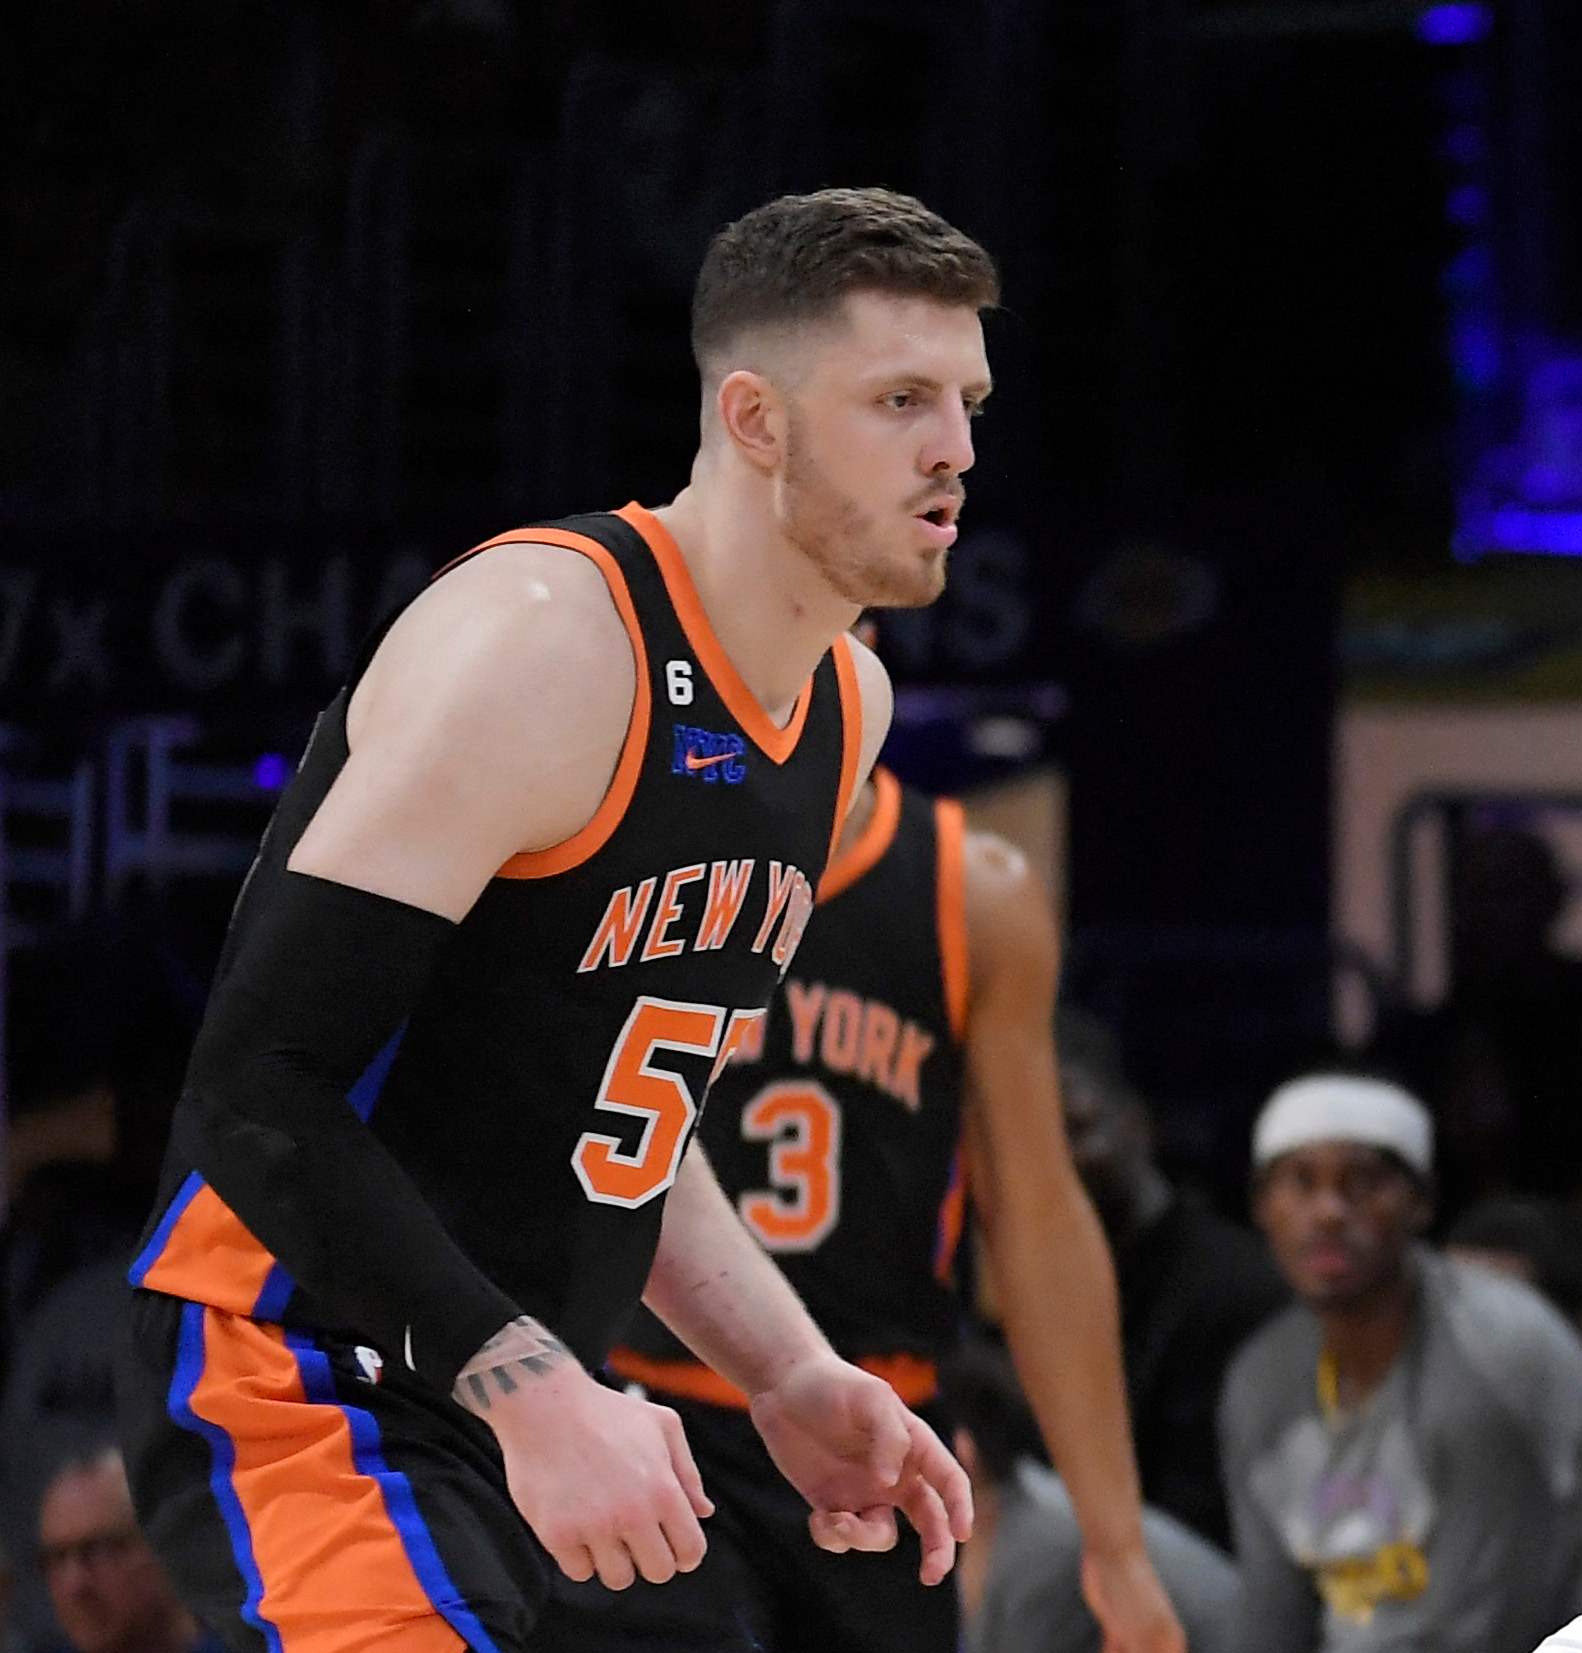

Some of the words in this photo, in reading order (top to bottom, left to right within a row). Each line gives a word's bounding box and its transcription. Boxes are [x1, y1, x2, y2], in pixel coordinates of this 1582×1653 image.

[665, 659, 694, 706] 6
[576, 858, 756, 974] NEW
[785, 978, 936, 1114] YORK
